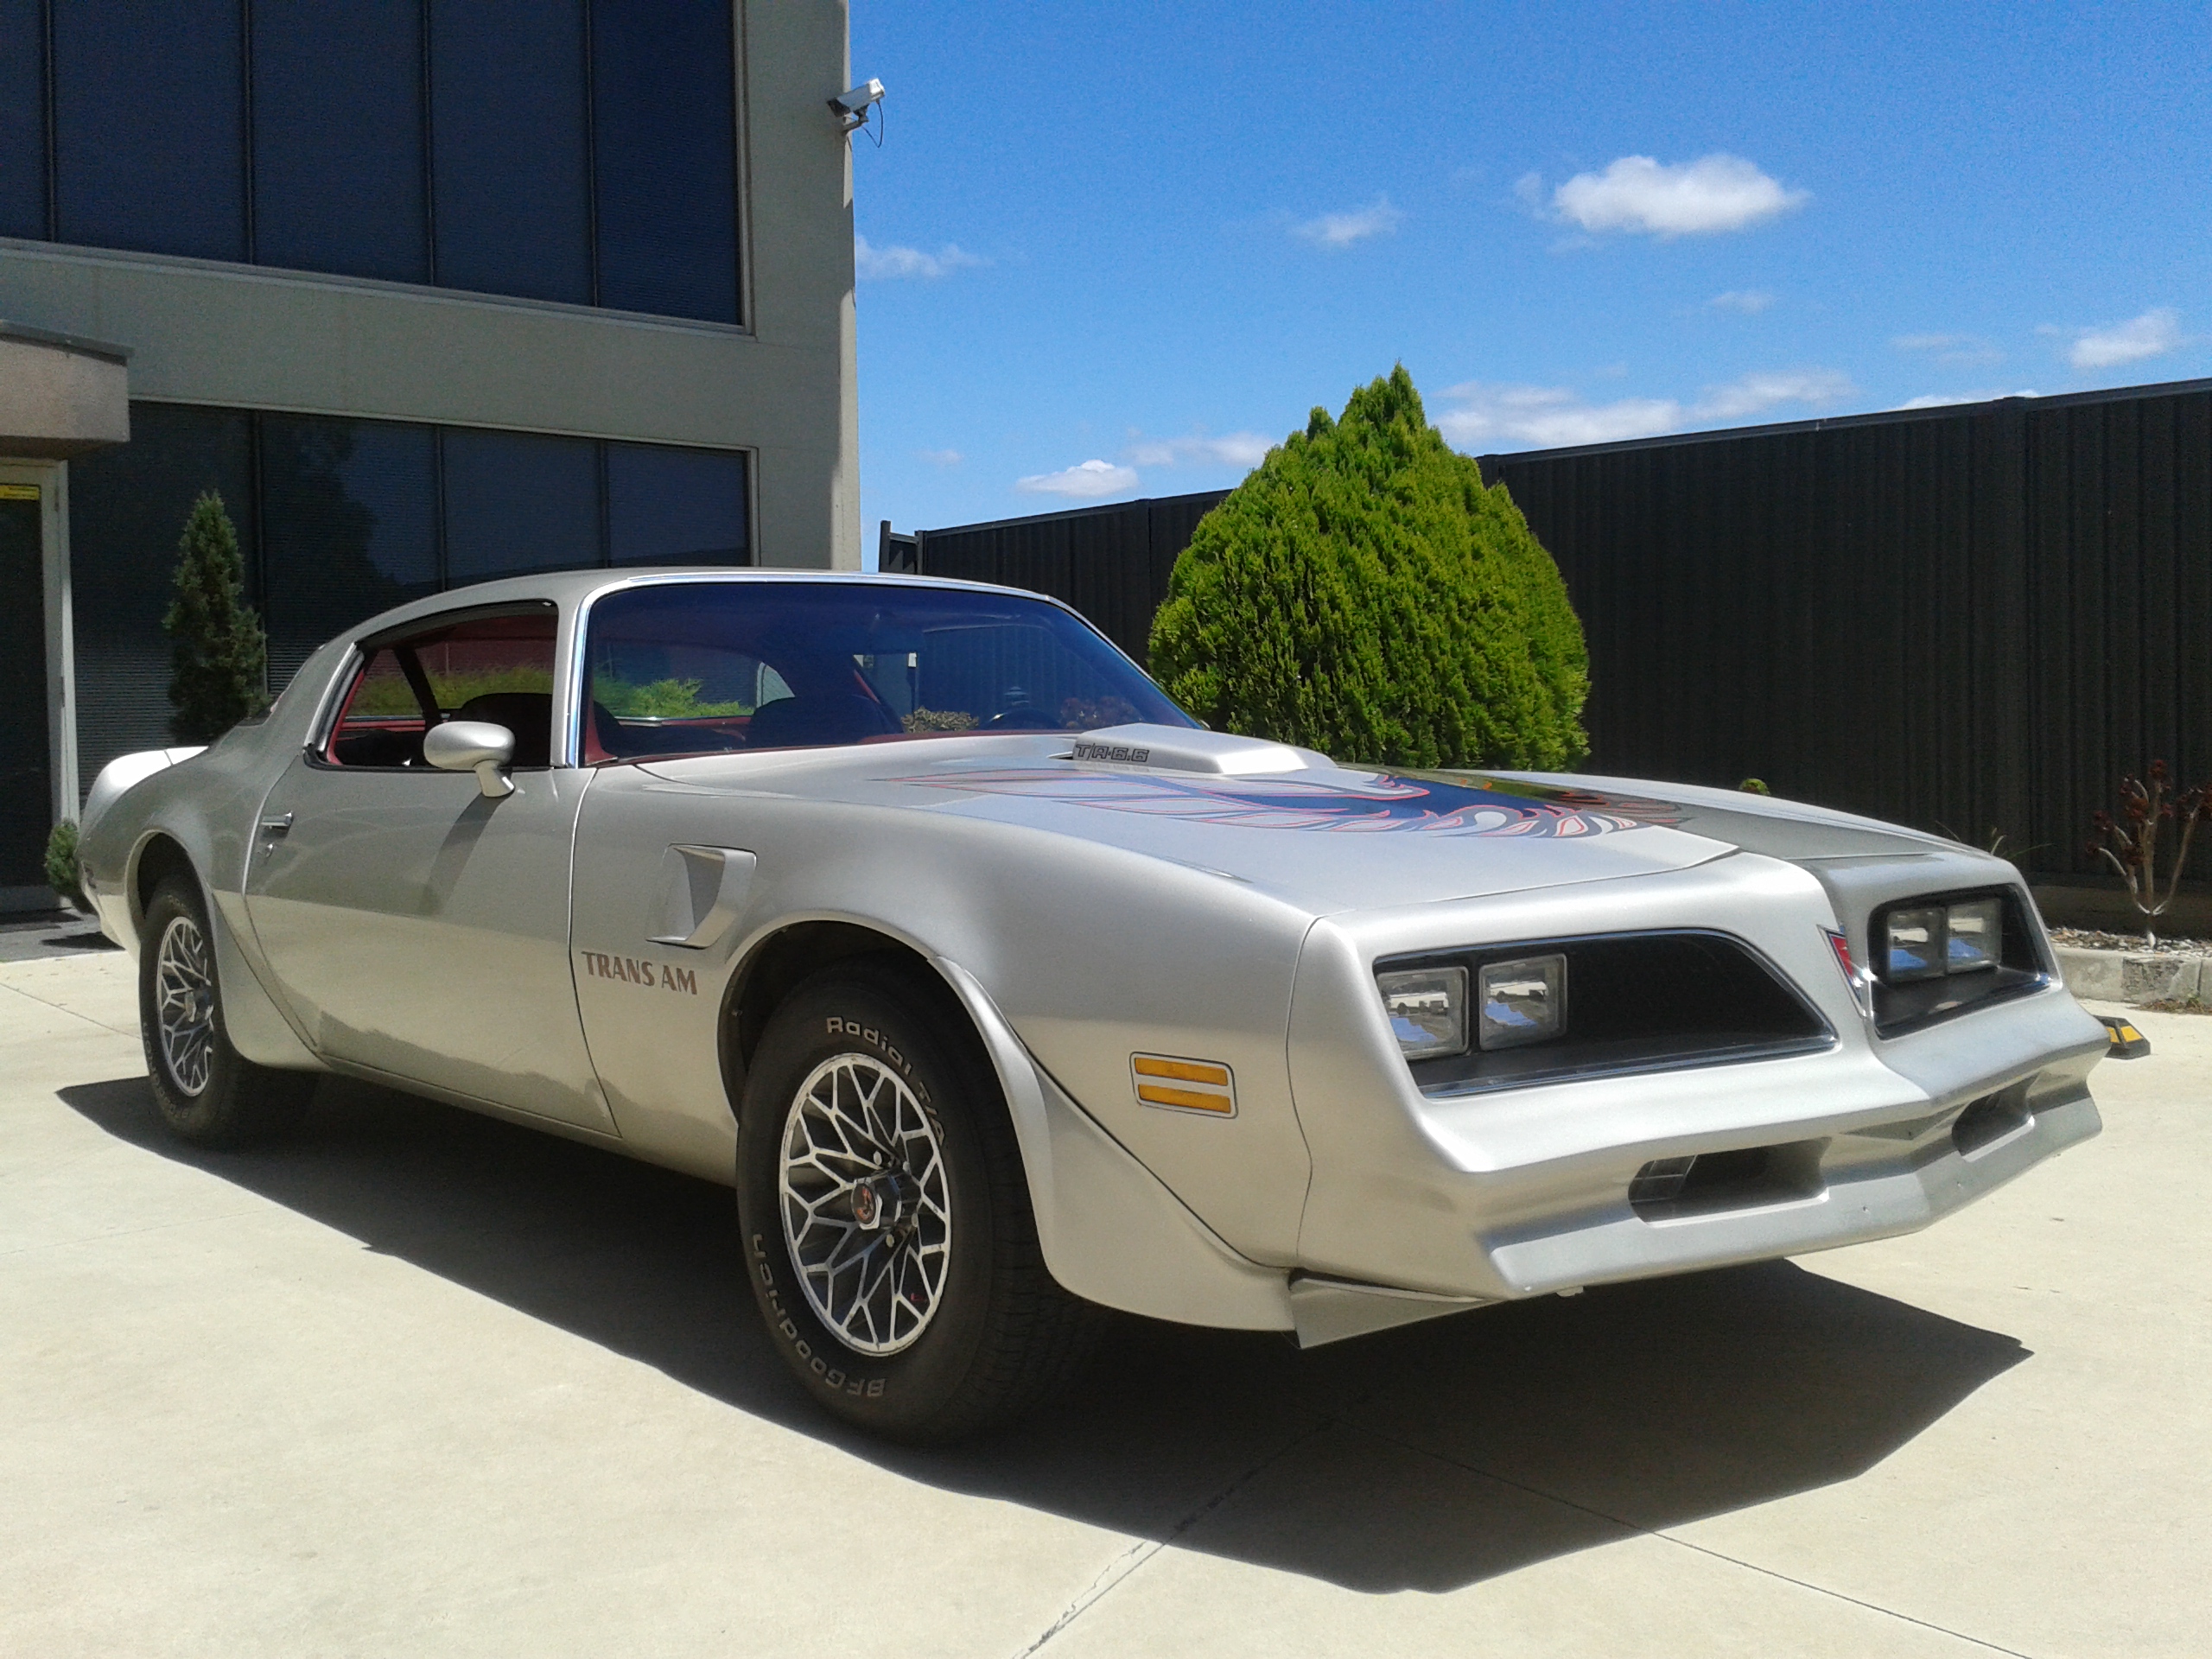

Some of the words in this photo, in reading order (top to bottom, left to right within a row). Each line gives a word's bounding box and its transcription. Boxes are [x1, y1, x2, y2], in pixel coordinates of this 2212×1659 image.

[581, 950, 655, 987] TRANS
[661, 964, 698, 995] AM
[826, 1016, 912, 1076] Radial
[753, 1234, 886, 1397] BFGoodrich
